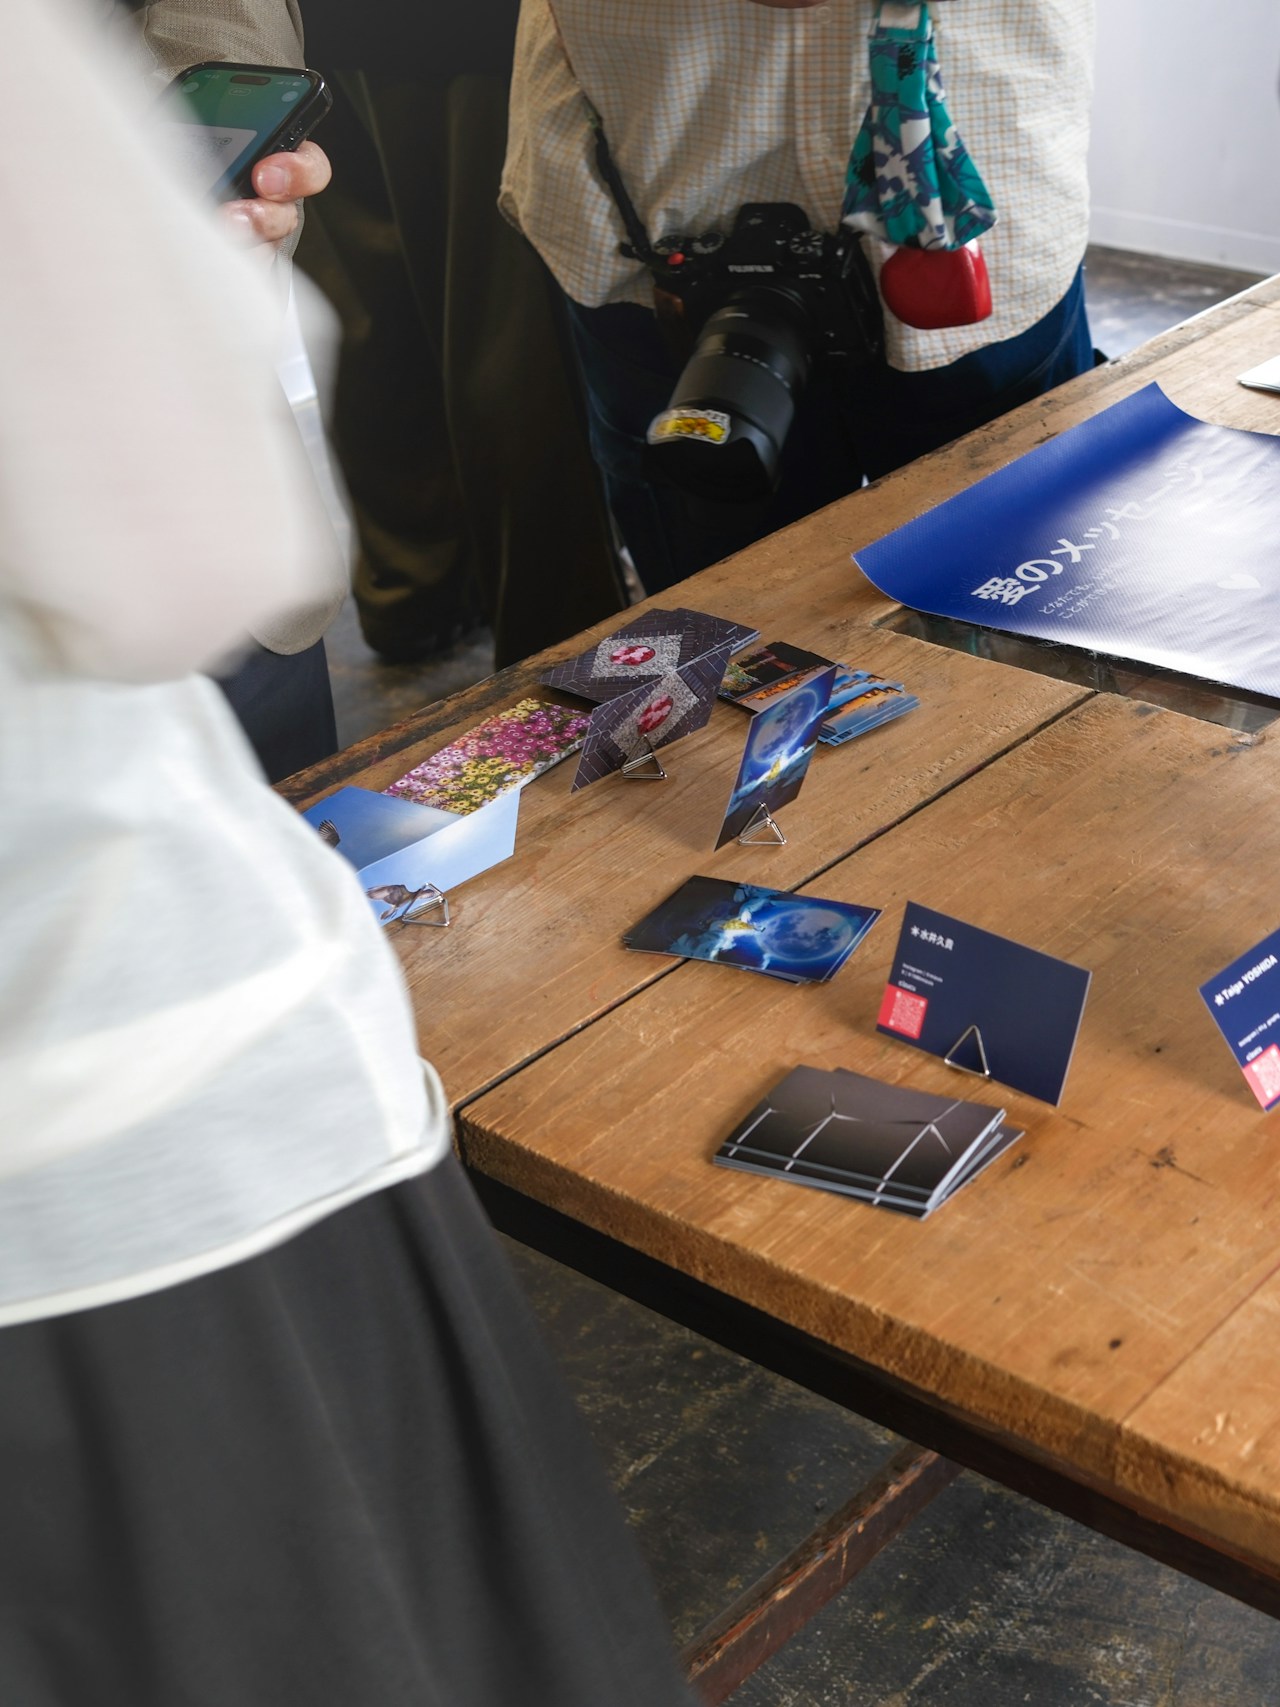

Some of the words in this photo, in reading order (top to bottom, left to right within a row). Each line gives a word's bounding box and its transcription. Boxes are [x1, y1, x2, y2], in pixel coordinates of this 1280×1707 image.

[970, 462, 1204, 606] 愛のメッセージ
[1221, 980, 1245, 1000] Taiga
[1241, 955, 1278, 984] YOSHIDA
